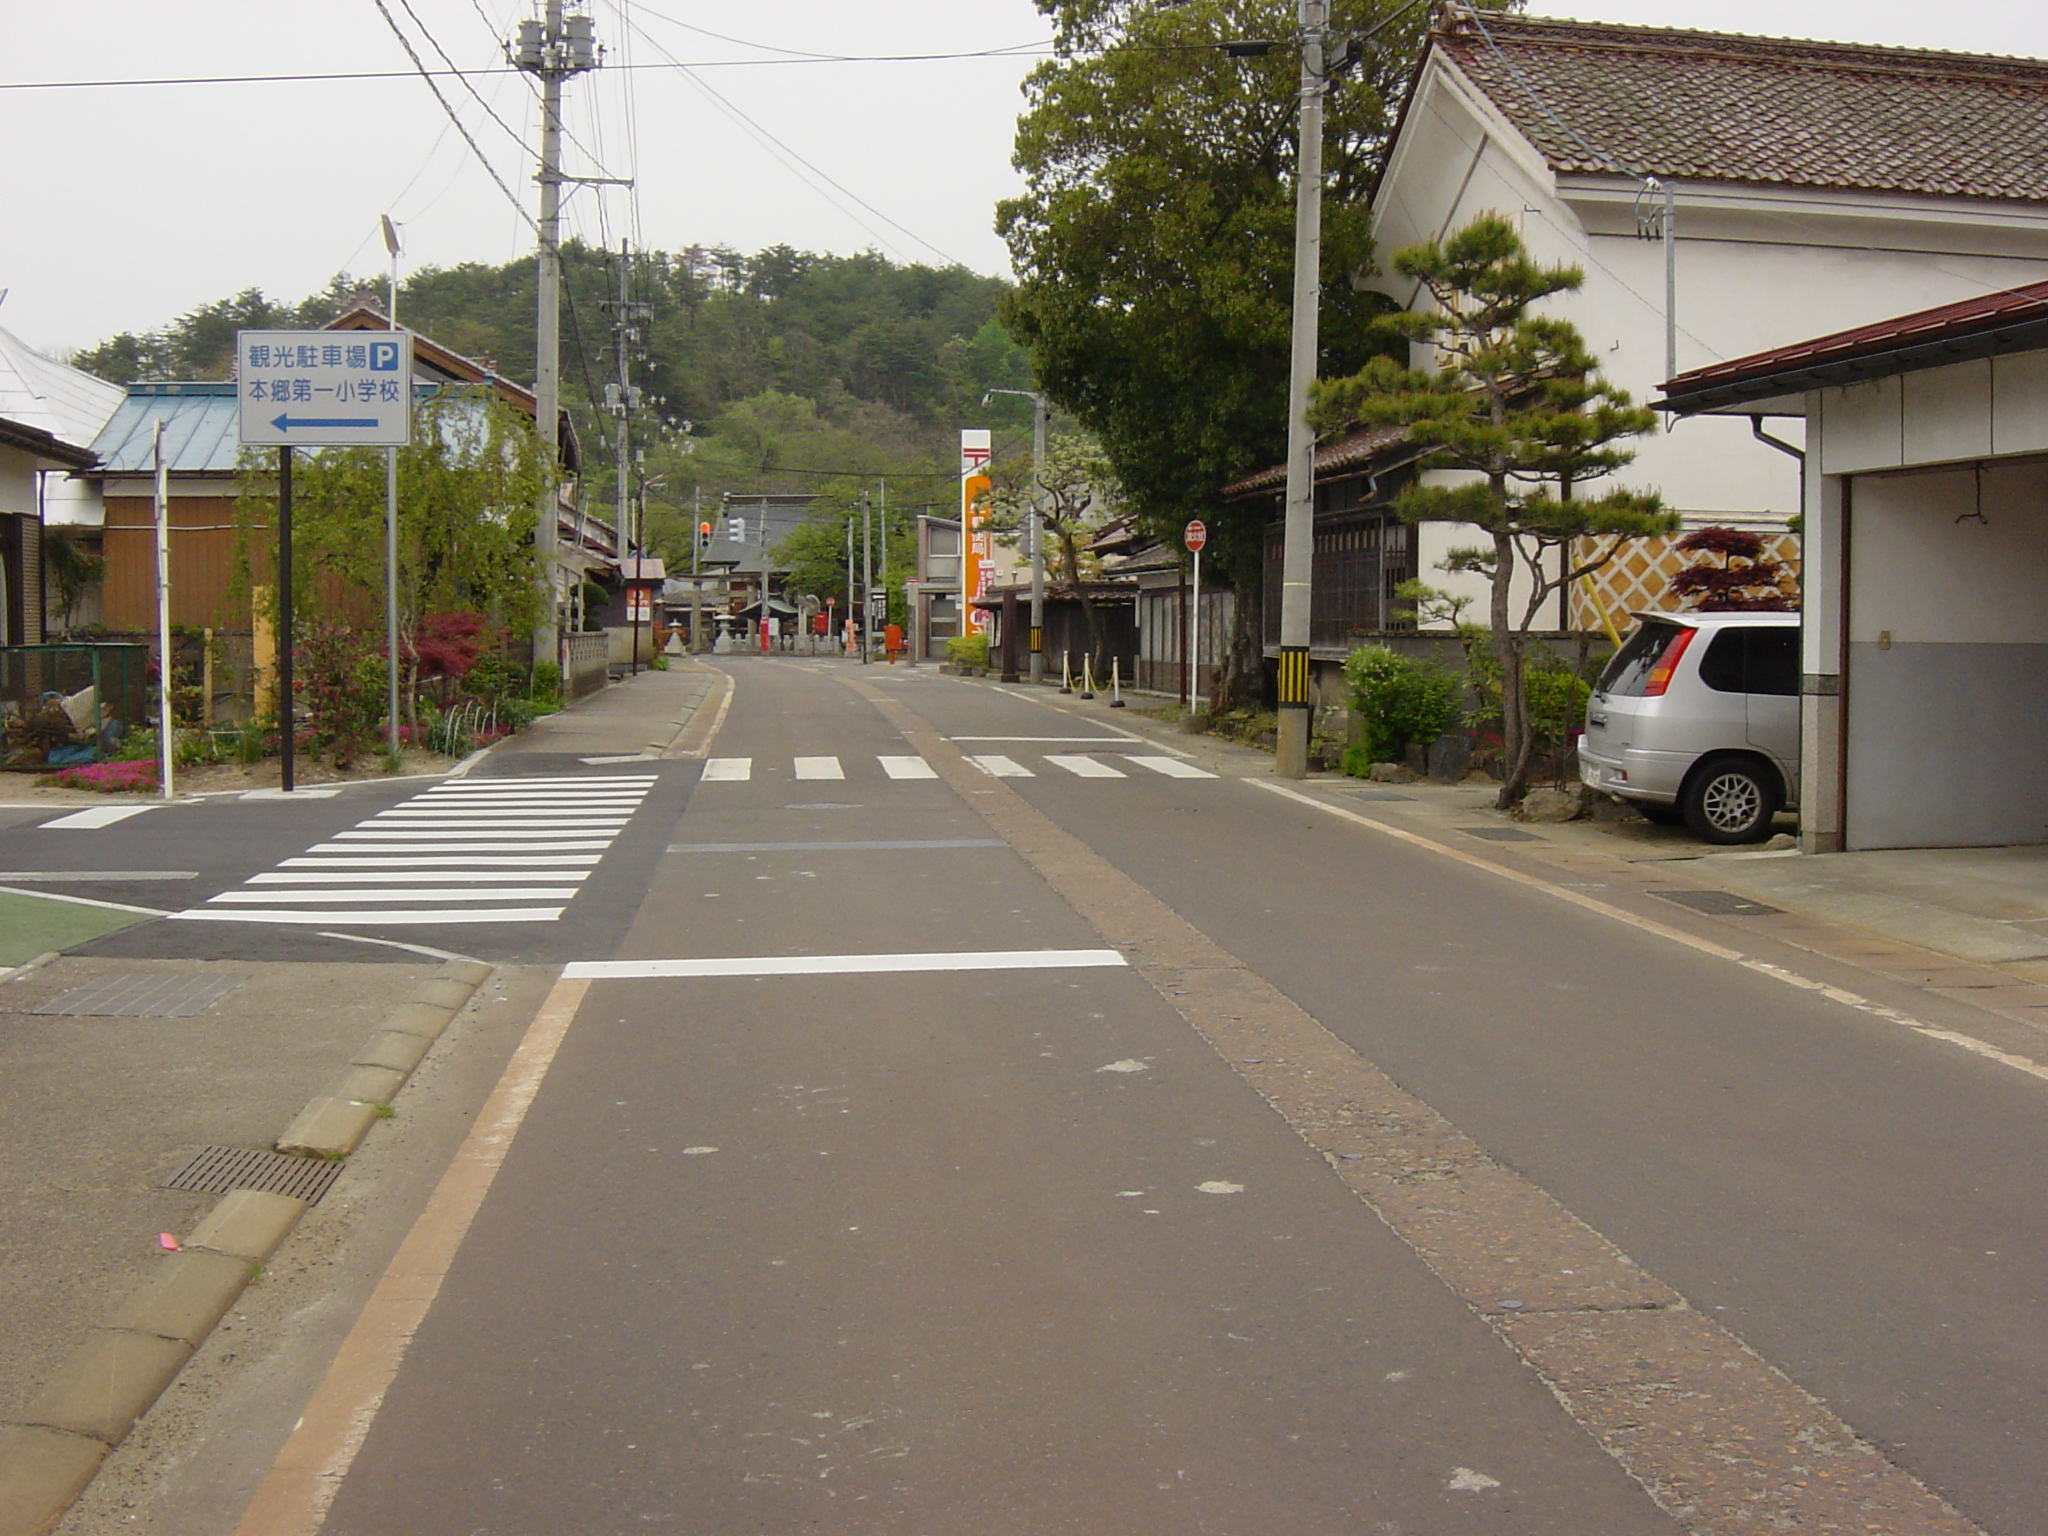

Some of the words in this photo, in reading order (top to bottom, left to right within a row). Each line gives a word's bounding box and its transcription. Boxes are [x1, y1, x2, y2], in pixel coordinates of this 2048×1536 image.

[248, 344, 367, 369] 観光駐車場
[248, 378, 400, 403] 本郷第一小学校
